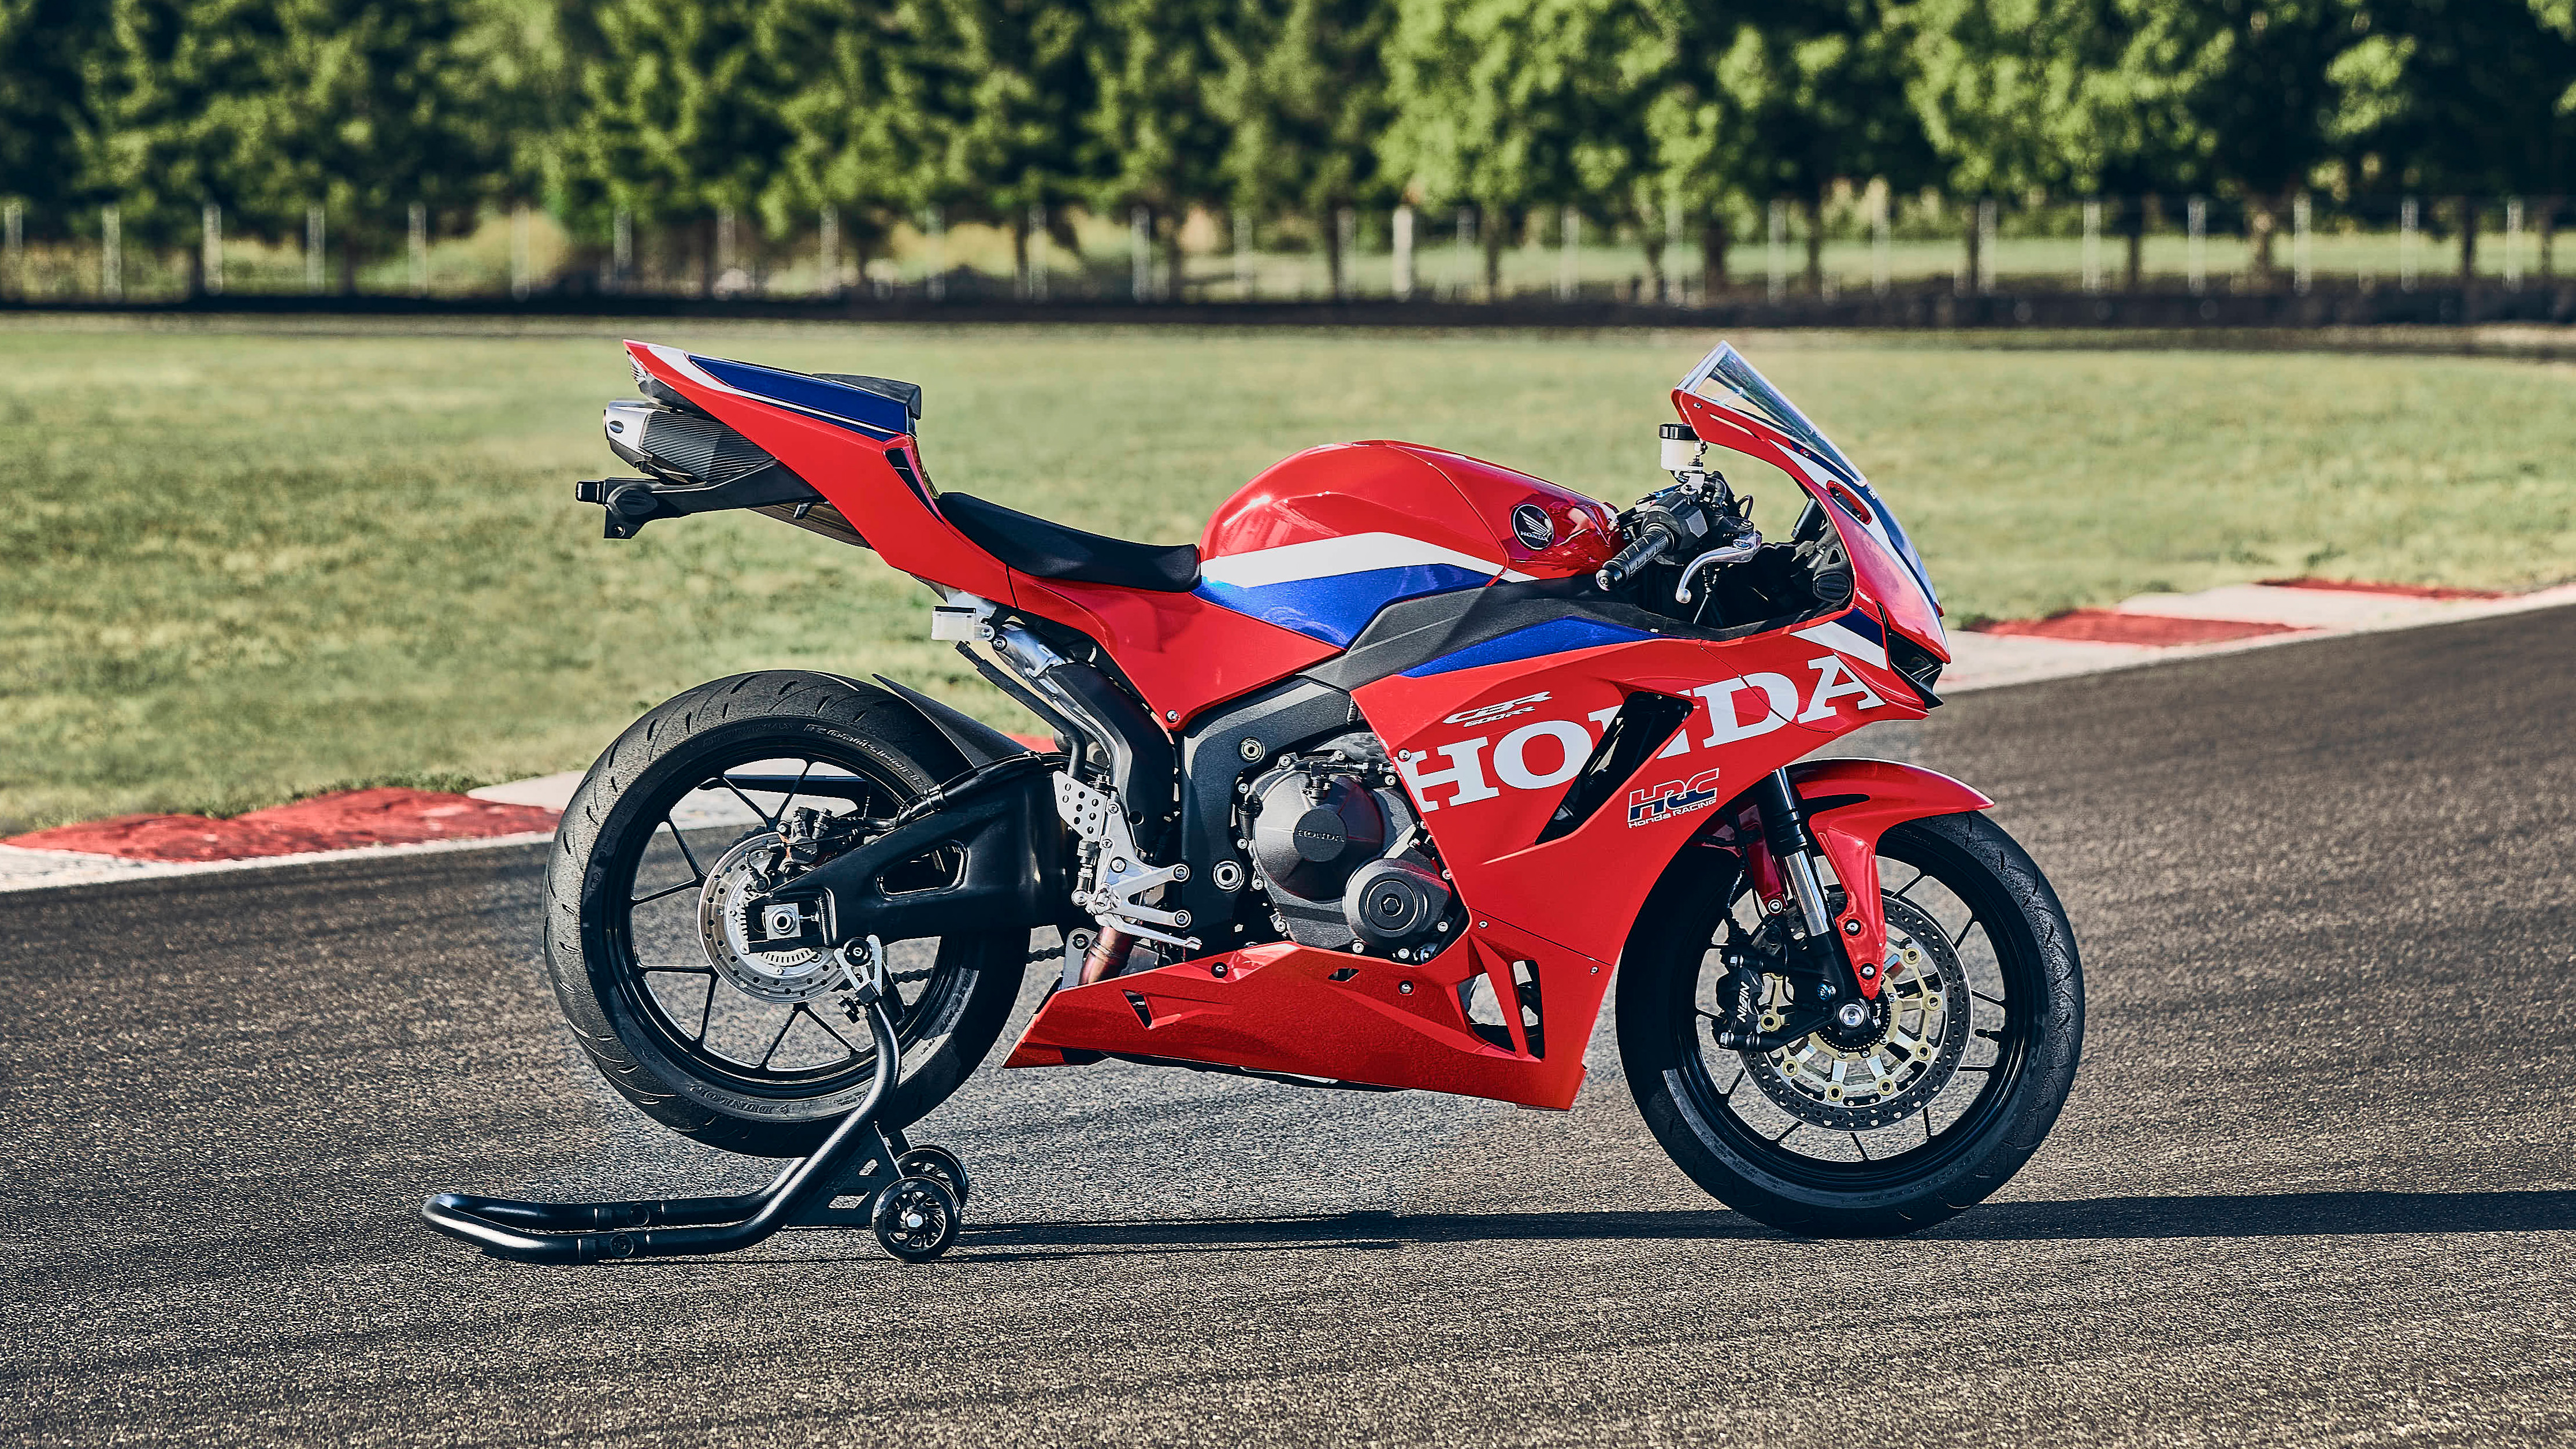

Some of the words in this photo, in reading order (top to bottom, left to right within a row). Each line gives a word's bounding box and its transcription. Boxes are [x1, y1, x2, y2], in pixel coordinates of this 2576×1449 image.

[1520, 531, 1549, 543] HONDA
[1442, 691, 1553, 724] CBR
[1627, 767, 1720, 823] HRC
[1628, 812, 1672, 828] Honda
[1672, 798, 1717, 816] RACING
[1297, 829, 1345, 843] HONDA
[689, 1084, 774, 1115] DUNLOP
